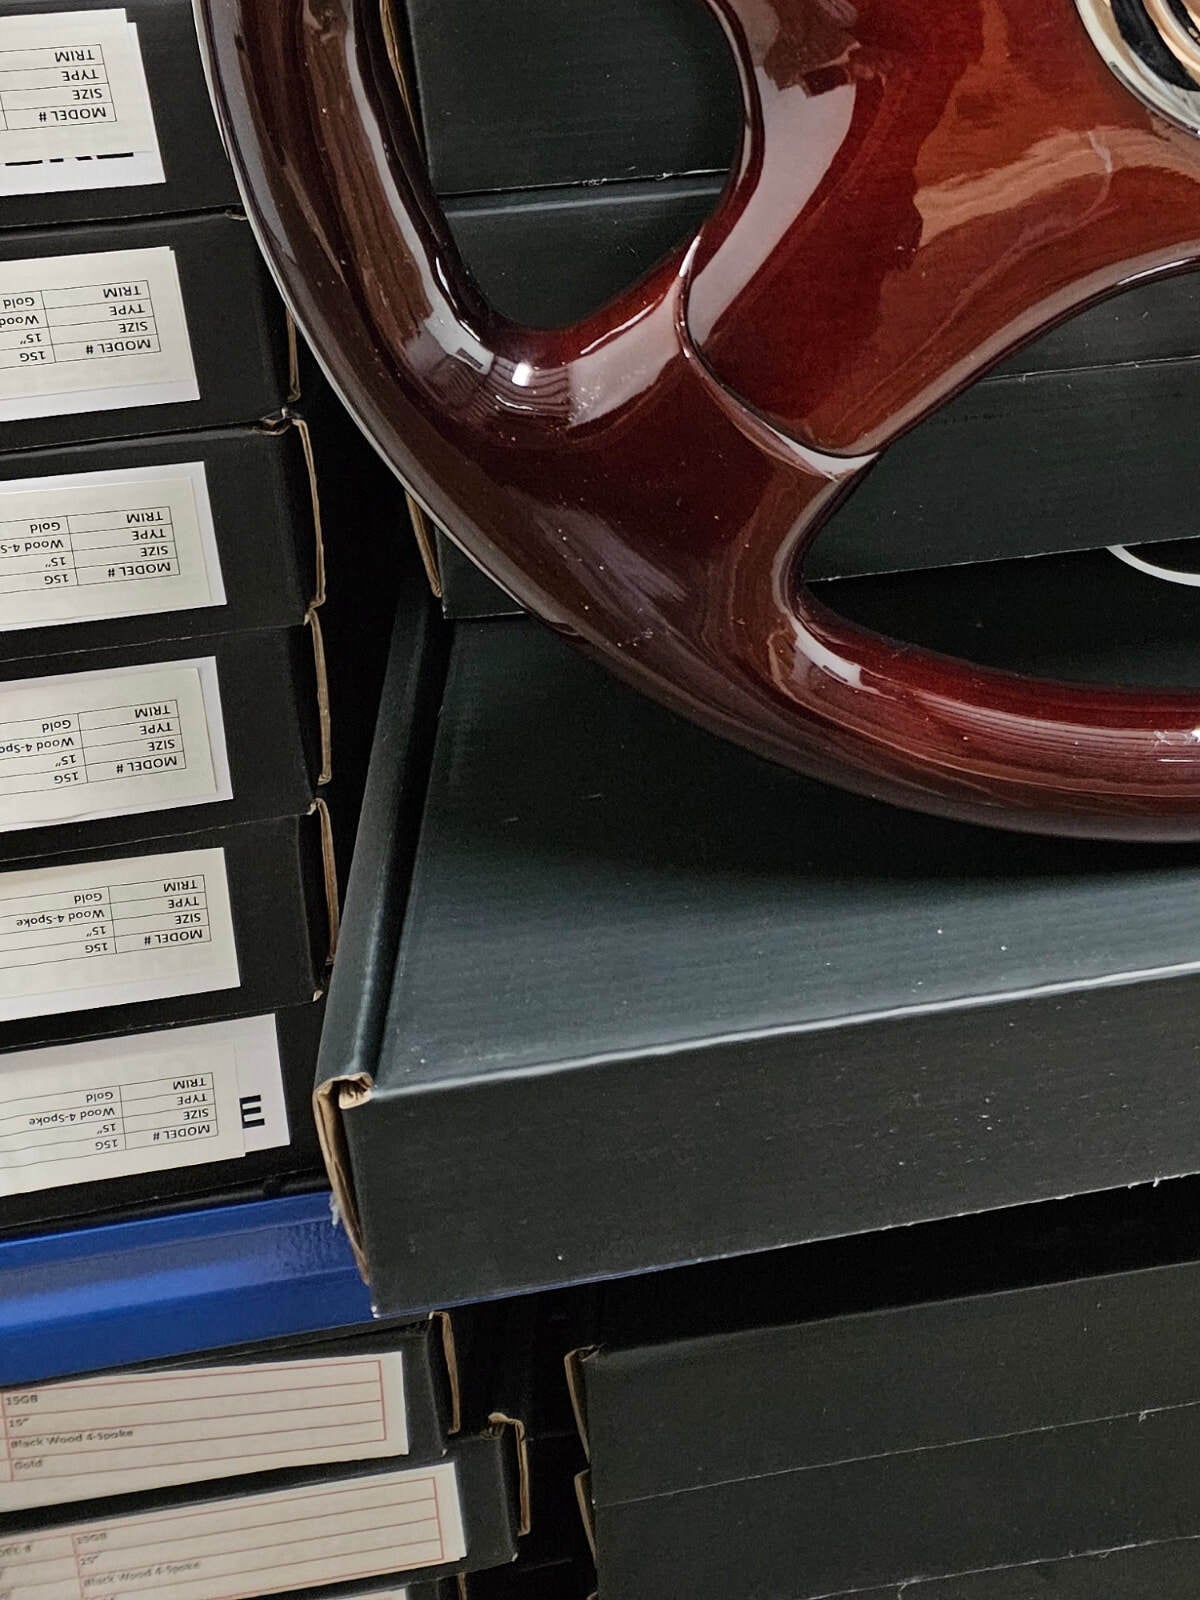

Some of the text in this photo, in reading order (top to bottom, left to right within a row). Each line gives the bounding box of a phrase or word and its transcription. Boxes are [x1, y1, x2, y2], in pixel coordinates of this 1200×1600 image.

[55, 49, 95, 62] TRIM
[61, 69, 100, 81] TYPE
[72, 88, 103, 100] SIZE
[39, 107, 106, 122] MODEL #
[4, 286, 141, 309] TRIM Gold
[109, 304, 145, 316] TYPE
[120, 321, 148, 333] SIZE
[20, 339, 151, 362] MODEL # 15G
[30, 511, 163, 534] TRIM Gold
[132, 528, 166, 541] TYPE
[24, 540, 64, 552] Wood
[141, 545, 169, 557] SIZE
[44, 562, 171, 585] MODEL # 15G
[42, 705, 171, 733] TRIM Gold
[140, 722, 173, 735] TYPE
[36, 737, 74, 752] Wood
[149, 739, 175, 751] SIZE
[53, 756, 177, 785] MODEL # 15G
[74, 880, 198, 905] TRIM Gold
[16, 896, 200, 928] TYPE Wood 4-Spoke
[175, 912, 201, 925] SIZE
[85, 929, 203, 954] MODEL # 15G
[86, 1077, 207, 1103] TRIM Gold
[29, 1093, 207, 1126] TYPE Wood 4-Spoke
[183, 1108, 209, 1121] SIZE
[95, 1124, 211, 1150] MODEL # 15G
